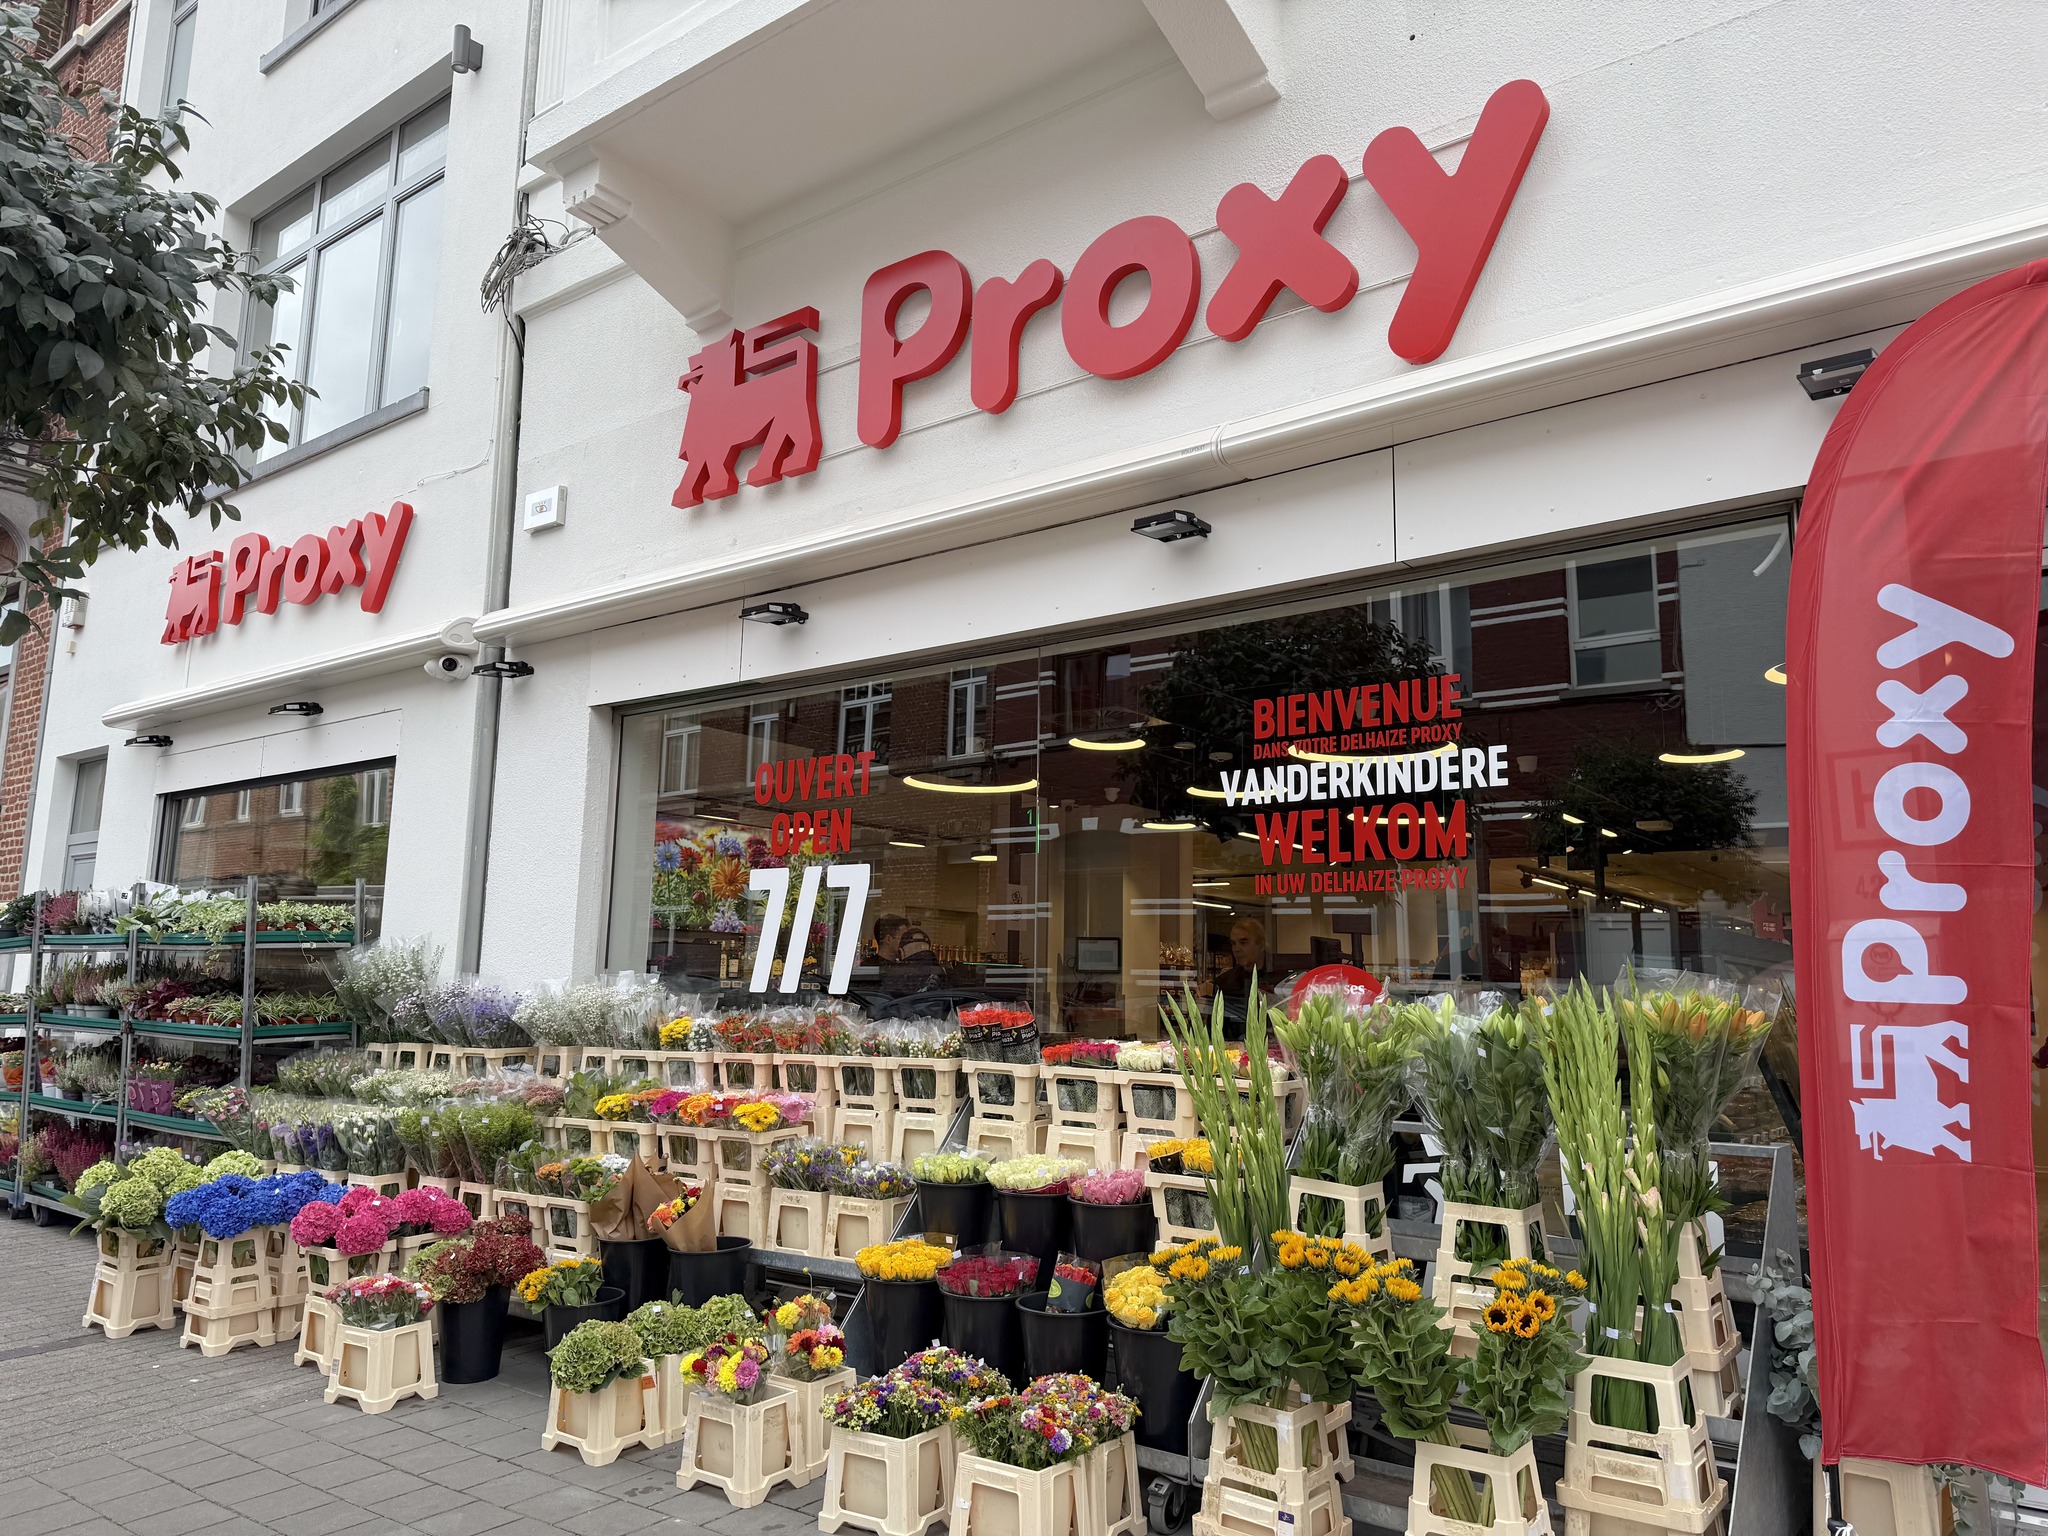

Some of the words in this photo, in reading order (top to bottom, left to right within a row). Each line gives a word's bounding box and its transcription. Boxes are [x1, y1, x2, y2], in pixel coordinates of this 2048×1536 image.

[857, 79, 1551, 450] Proxy
[223, 501, 414, 626] Proxy
[1254, 674, 1462, 739] BIENVENUE
[1253, 740, 1290, 760] DANS
[1293, 736, 1337, 756] VOTRE
[1341, 729, 1407, 751] DELHAIZE
[1411, 722, 1463, 744] PROXY
[754, 751, 875, 805] OUVERT
[1219, 744, 1509, 807] VANDERKINDERE
[1842, 583, 2014, 1005] Proxy
[771, 807, 852, 857] OPEN
[1254, 800, 1467, 866] WELKOM
[1255, 874, 1272, 895] IN
[1276, 872, 1305, 893] UW
[1311, 869, 1395, 893] DELHAIZE
[1402, 866, 1468, 892] PROXY
[749, 863, 871, 995] 7/7
